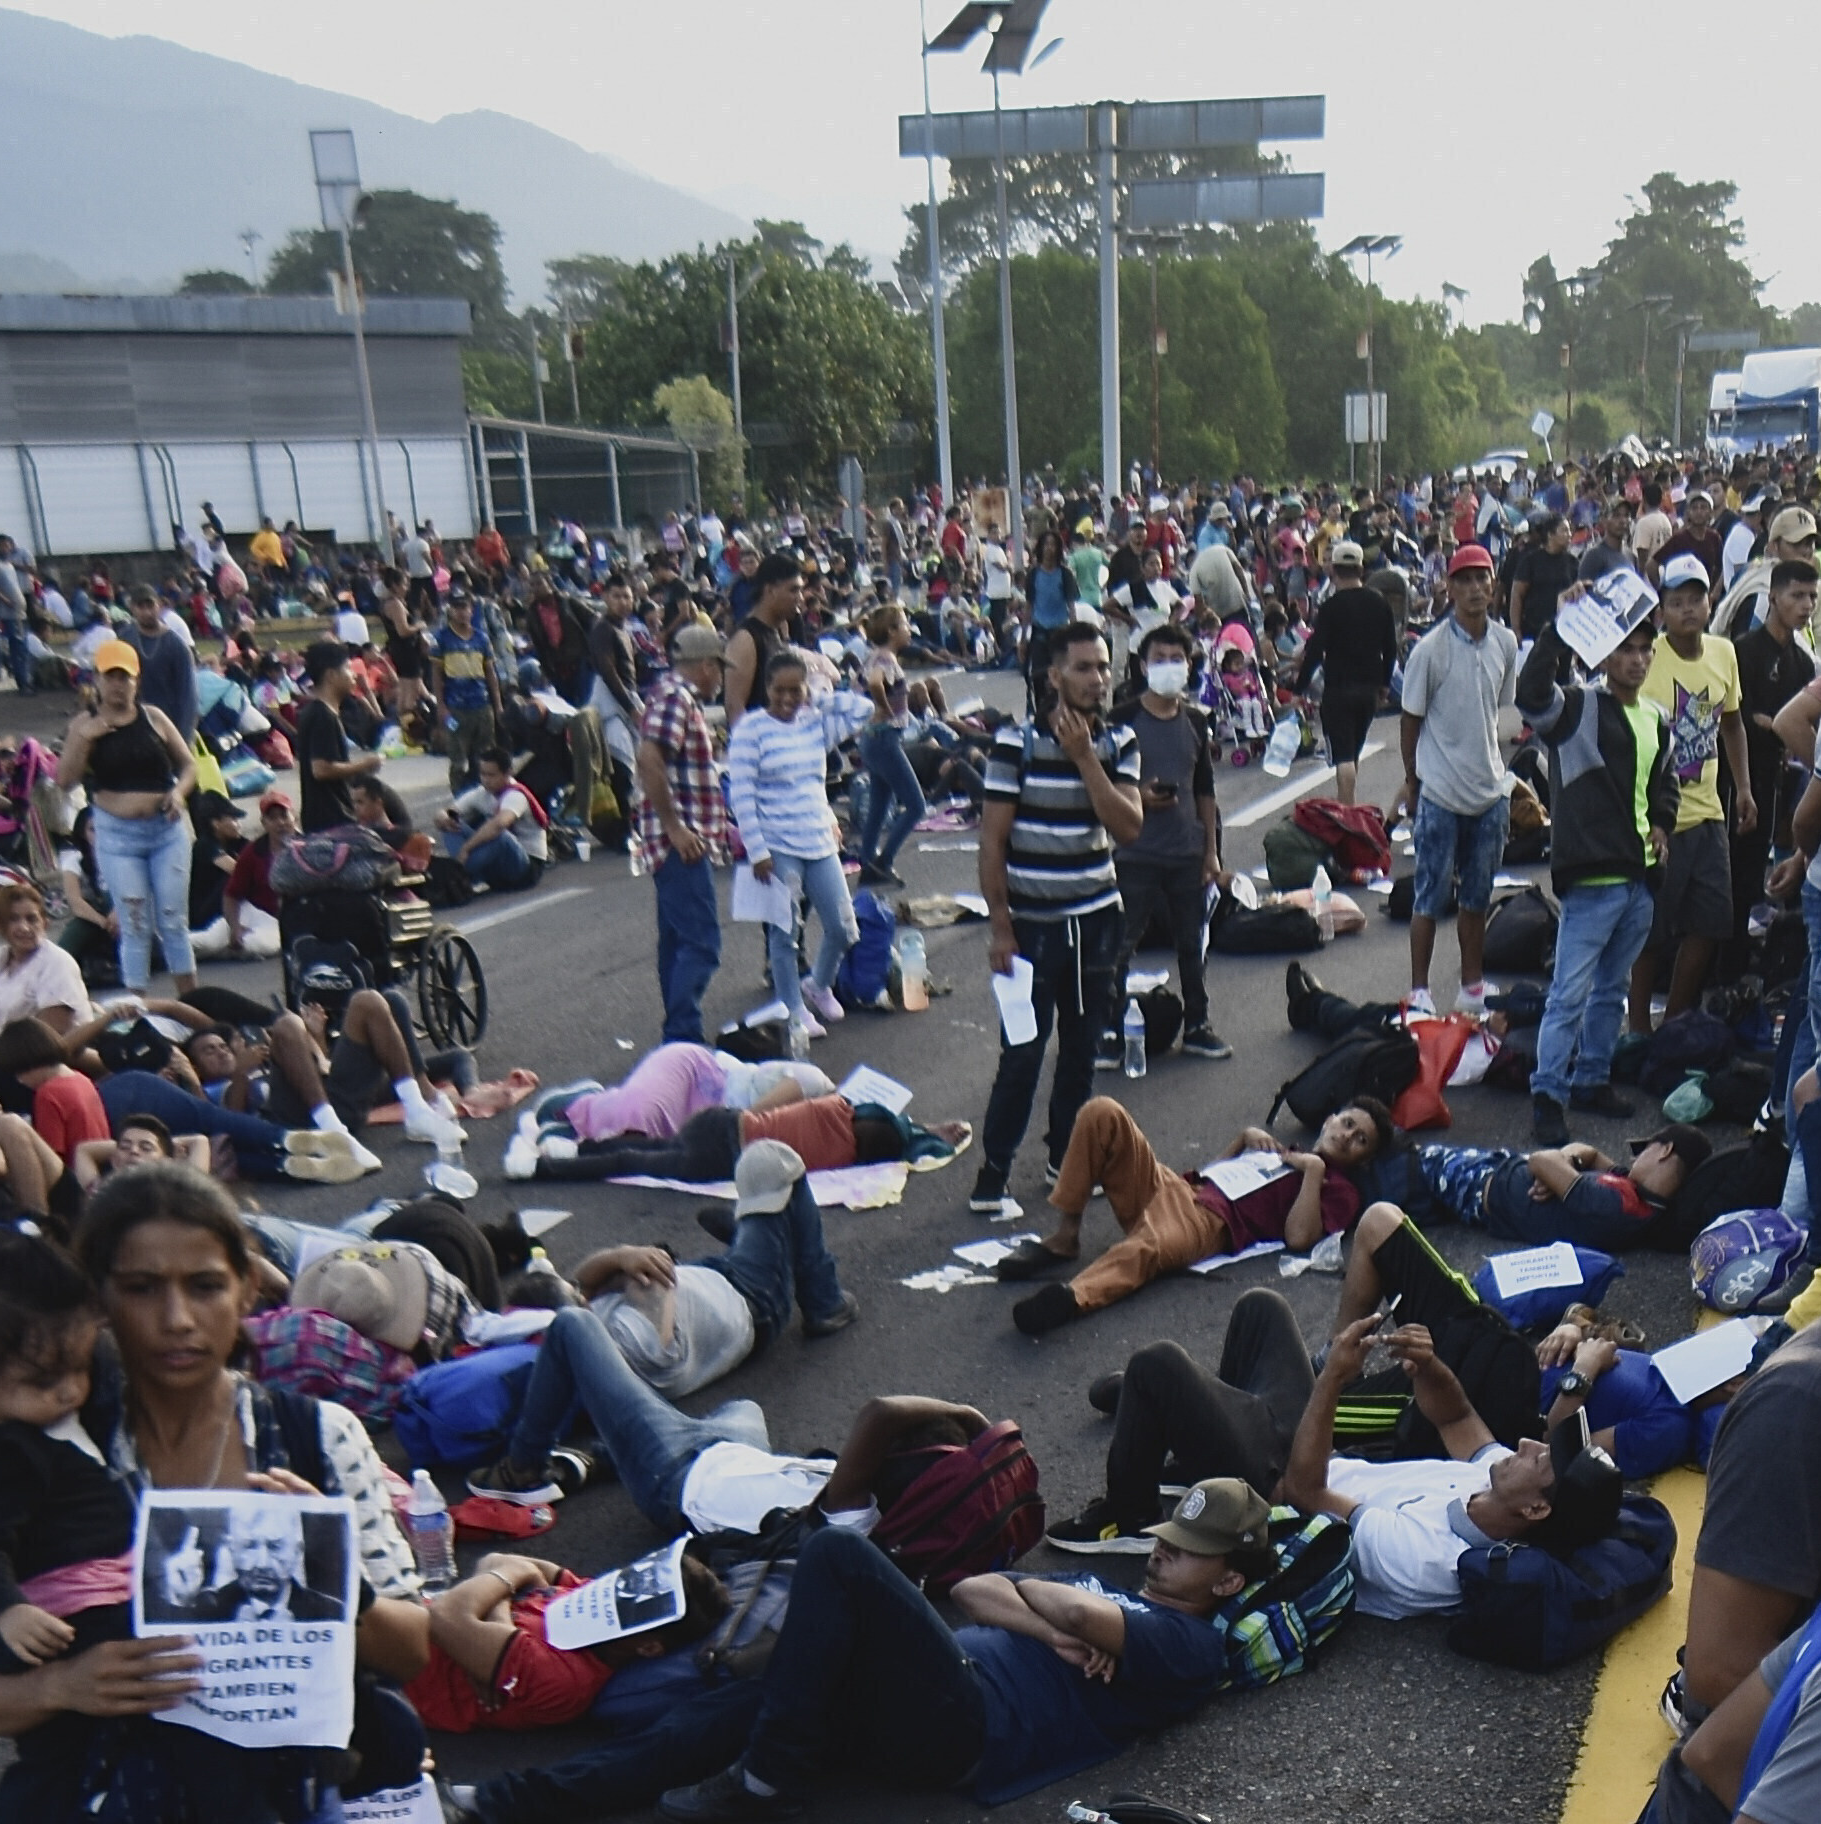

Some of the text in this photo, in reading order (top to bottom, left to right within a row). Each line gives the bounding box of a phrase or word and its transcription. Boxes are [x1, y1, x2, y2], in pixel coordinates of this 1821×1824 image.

[195, 1629, 334, 1647] VIDA DE LOS
[202, 1655, 313, 1672] IGRANTES
[199, 1682, 297, 1699] TAMBIEN
[392, 1788, 421, 1802] LOS
